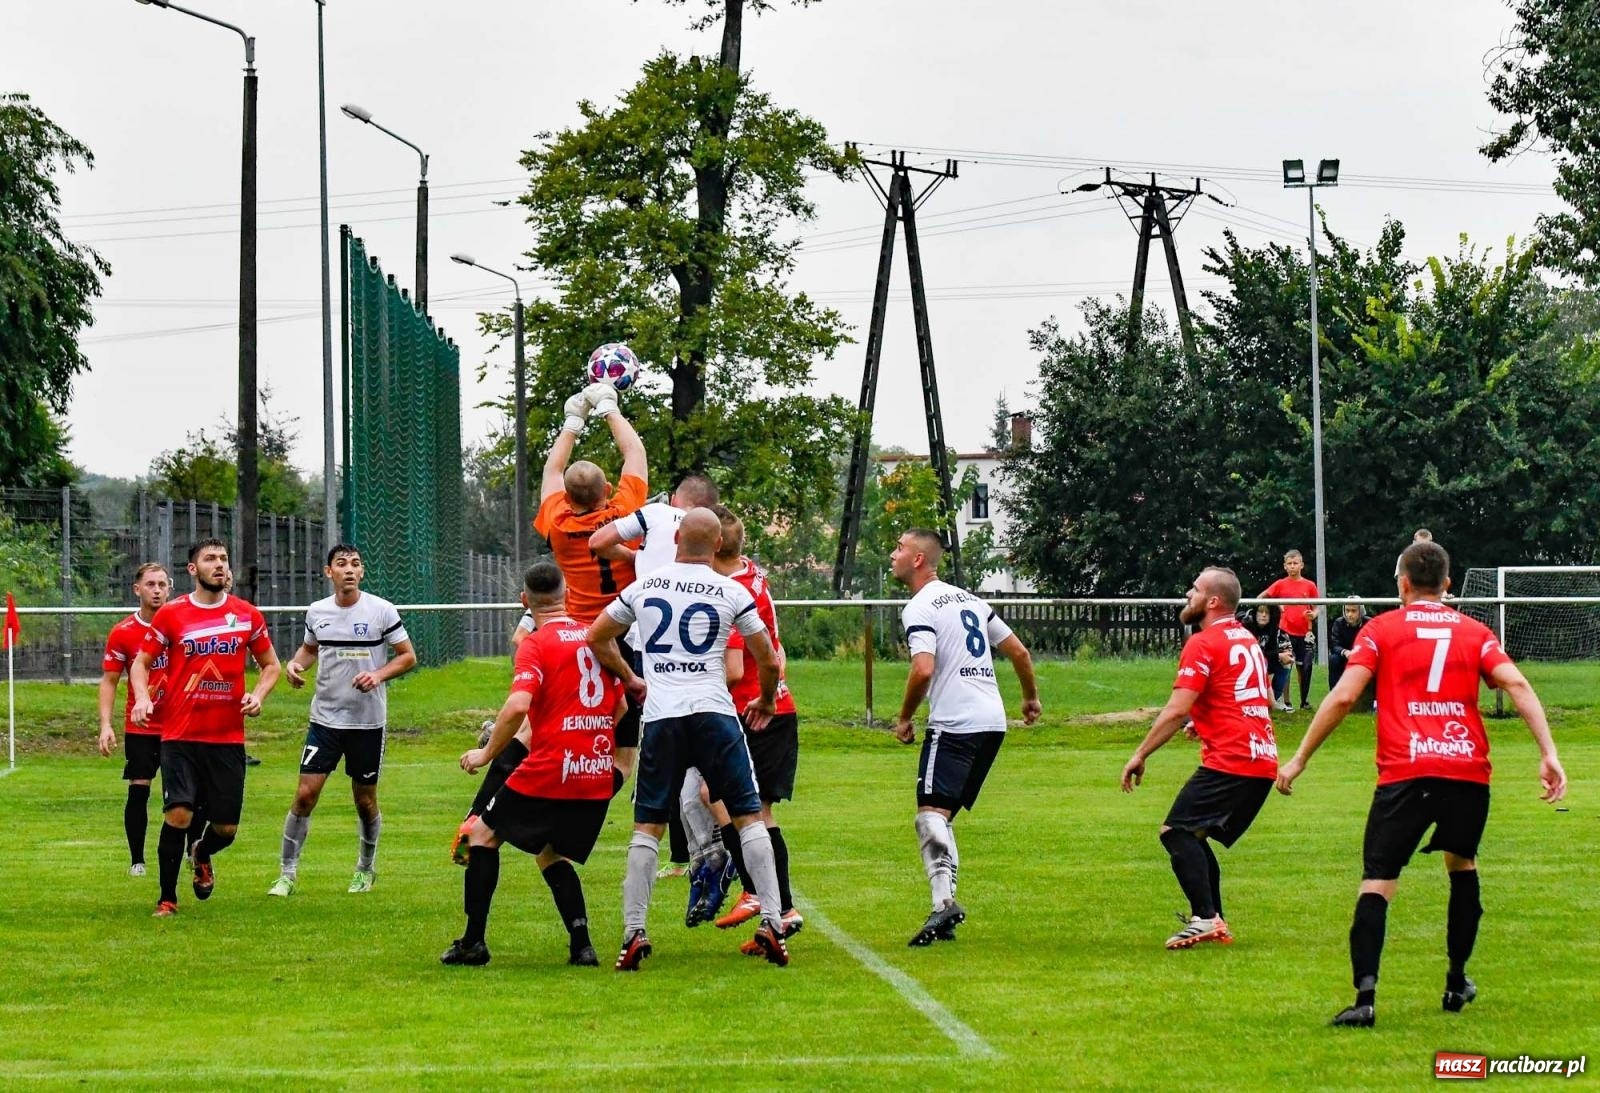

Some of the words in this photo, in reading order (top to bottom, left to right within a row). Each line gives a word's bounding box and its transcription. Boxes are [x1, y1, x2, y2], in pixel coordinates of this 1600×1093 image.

[642, 578, 670, 589] 1908
[643, 597, 720, 655] 20
[960, 609, 986, 658] 8
[576, 646, 604, 708] 8
[654, 662, 707, 673] EKO-TOX
[1229, 643, 1268, 703] 20
[1416, 627, 1453, 693] 7
